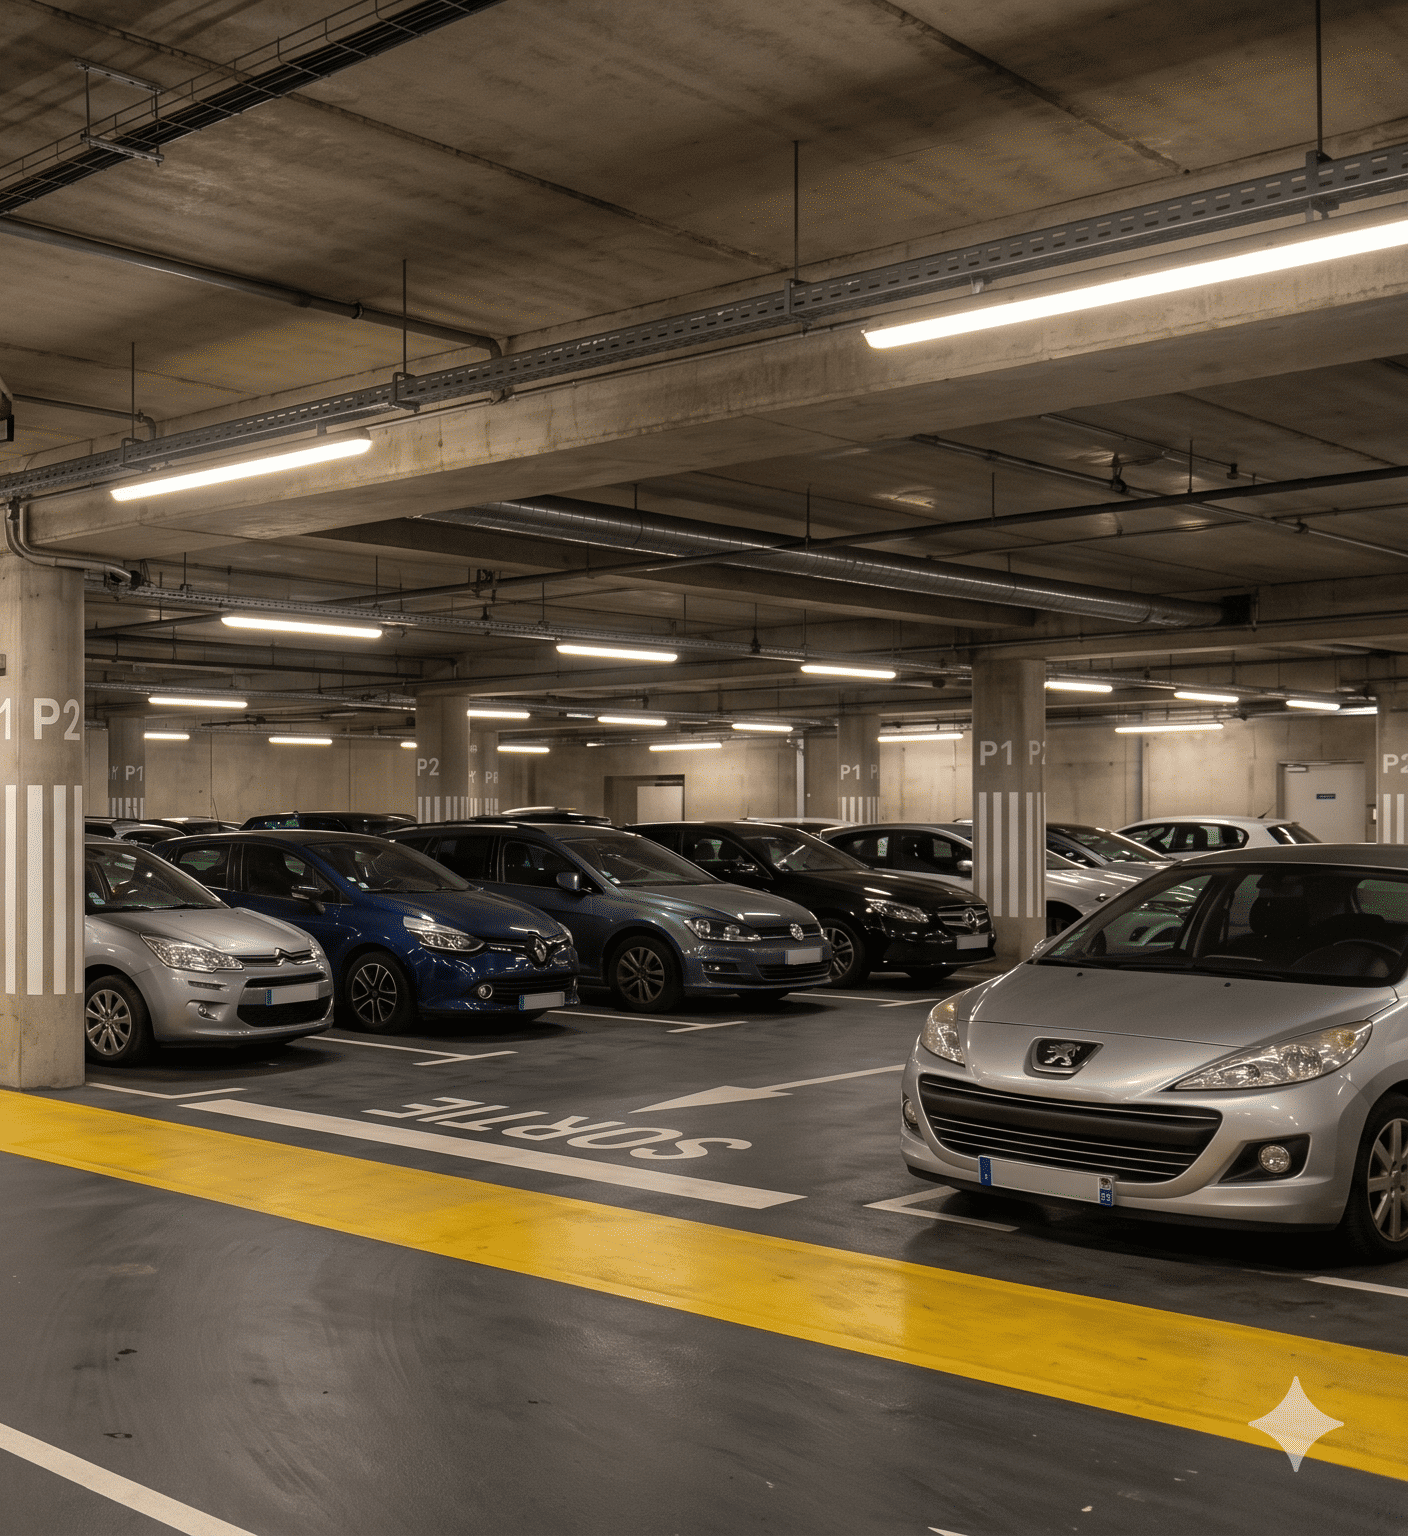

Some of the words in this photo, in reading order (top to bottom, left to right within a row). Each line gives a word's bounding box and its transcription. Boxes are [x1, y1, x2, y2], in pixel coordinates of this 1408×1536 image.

[33, 697, 81, 741] P2
[980, 740, 1012, 766] P1
[125, 765, 143, 781] P1
[417, 757, 440, 776] P2
[841, 764, 860, 780] P1
[361, 1096, 753, 1160] SORTIE
